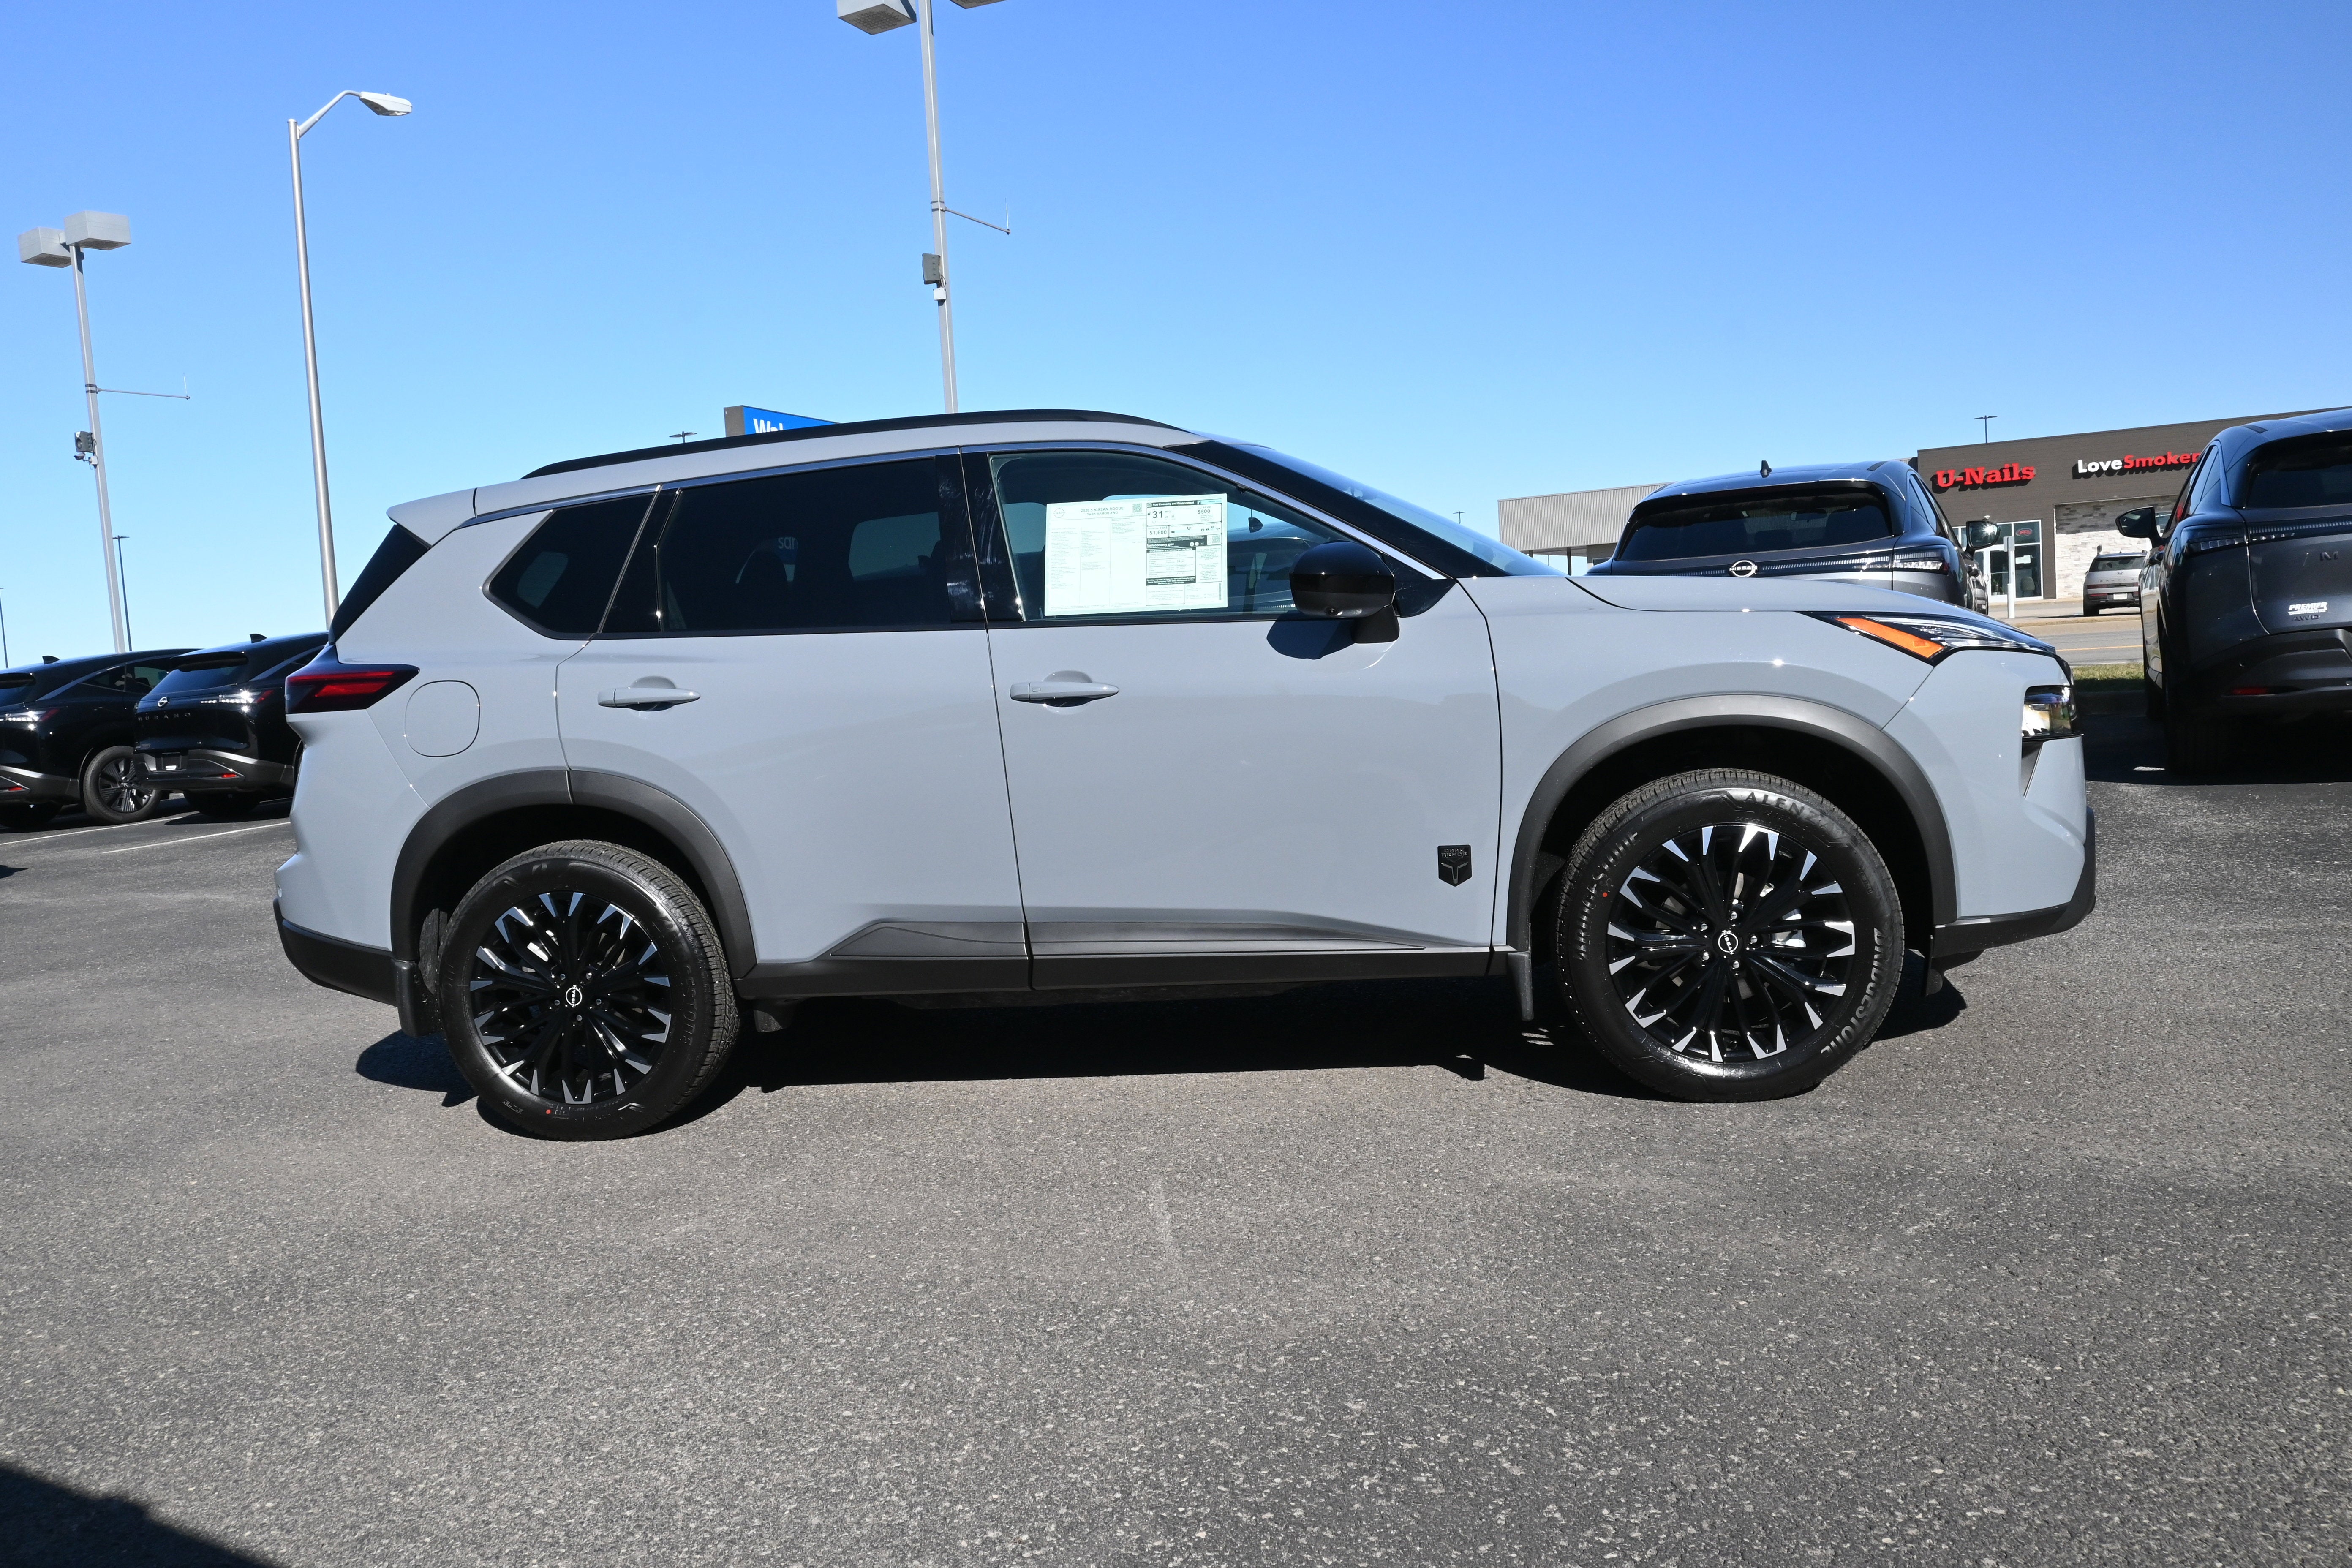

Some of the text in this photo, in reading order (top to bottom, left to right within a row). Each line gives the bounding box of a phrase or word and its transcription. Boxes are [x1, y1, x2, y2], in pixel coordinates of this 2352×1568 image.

[1936, 463, 2035, 487] U-Nails
[1152, 510, 1162, 518] 31
[2289, 602, 2328, 611] PREMIER
[138, 713, 190, 721] MURANO
[1722, 930, 1734, 955] NISSAN
